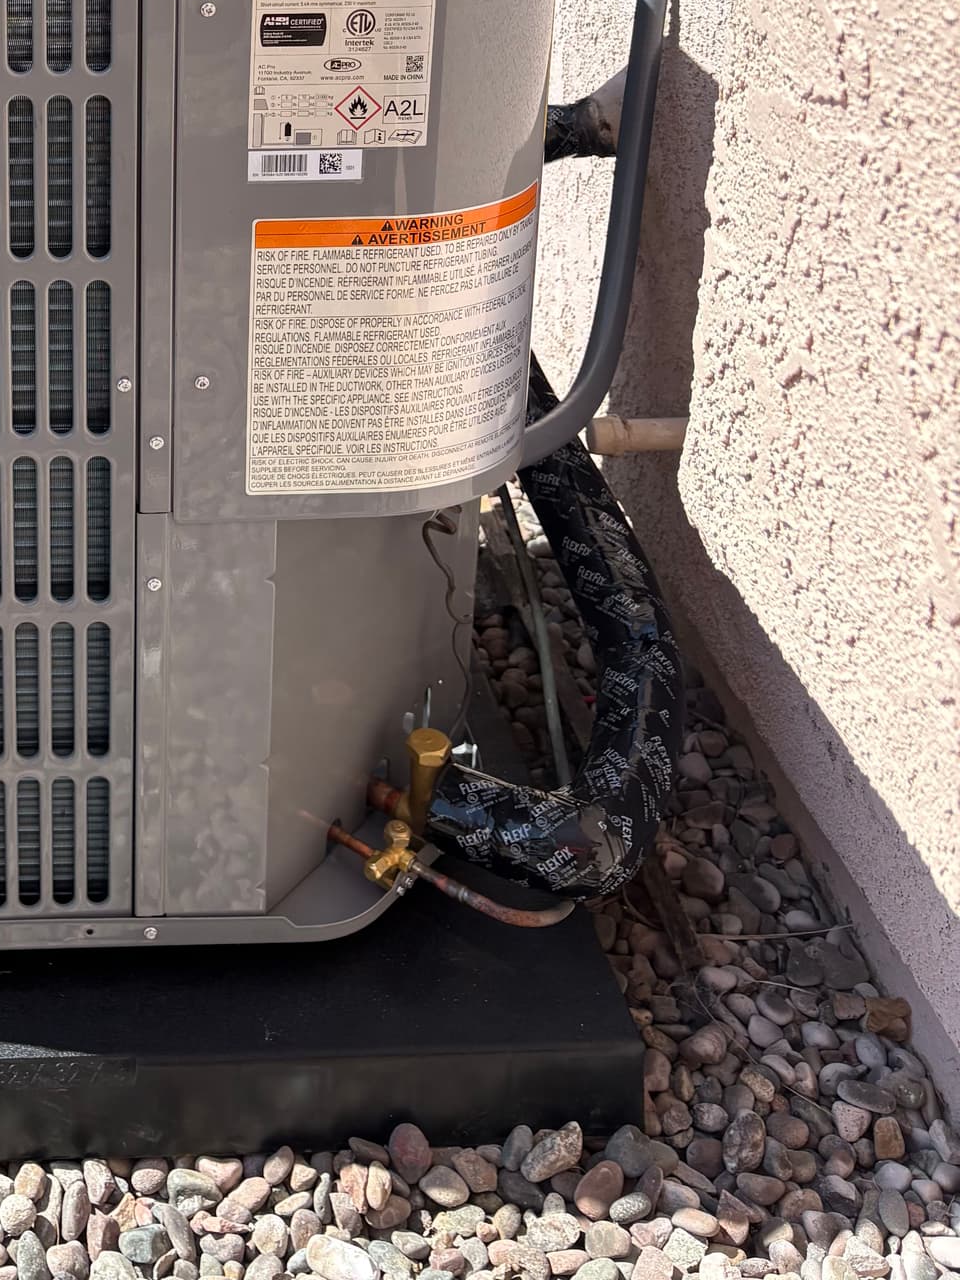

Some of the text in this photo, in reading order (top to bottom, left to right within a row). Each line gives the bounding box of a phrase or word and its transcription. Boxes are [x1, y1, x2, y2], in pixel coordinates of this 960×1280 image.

[384, 100, 423, 116] A2L
[395, 214, 464, 231] WARNING
[368, 222, 486, 245] AVERTISSEMENT
[257, 251, 276, 261] RISK
[278, 251, 289, 261] OF
[313, 249, 361, 260] FLAMMABLE
[363, 246, 419, 259] REFRIGERANT
[445, 242, 455, 253] TO
[456, 240, 465, 252] BE
[257, 264, 291, 275] SERVICE
[346, 263, 358, 273] DO
[360, 262, 377, 273] NOT
[379, 260, 421, 272] PUNCTURE
[424, 252, 473, 270] REFRIGERANT
[256, 270, 447, 288] RISQUE INFLAMMABLE
[256, 291, 272, 301] PAR
[274, 291, 285, 301] DU
[288, 290, 335, 301] PERSONNEL
[337, 290, 348, 300] DE
[350, 289, 385, 300] SERVICE
[418, 286, 429, 297] NE
[431, 282, 459, 296] PERCEZ
[461, 279, 473, 291] PAS
[256, 320, 274, 330] RISK
[276, 319, 287, 329] OF
[311, 318, 345, 329] DISPOSE
[347, 318, 359, 328] OF
[360, 317, 402, 328] PROPERLY
[404, 316, 412, 327] IN
[413, 309, 463, 326] ACCORDANCE
[465, 305, 481, 318] WITH
[314, 328, 419, 342] FLAMMABLE REFRIGERANT
[255, 337, 440, 355] RISQUE DISPOSEZ CORRECTEMENT
[254, 370, 272, 381] RISK
[274, 370, 285, 380] OF
[287, 370, 305, 380] FIRE
[313, 369, 353, 379] AUXILIARY
[355, 368, 389, 379] DEVICES
[391, 366, 416, 377] WHICH
[418, 364, 434, 375] MAY
[435, 362, 444, 373] BE
[446, 356, 475, 372] IGNITION
[380, 355, 392, 365] OU
[254, 383, 264, 393] BE
[267, 382, 308, 393] INSTALLED
[310, 382, 318, 392] IN
[320, 382, 335, 392] THE
[386, 379, 413, 390] OTHER
[415, 376, 434, 388] THAN
[435, 369, 470, 386] AUXILIARY
[254, 396, 270, 406] USE
[272, 395, 291, 406] WITH
[293, 395, 309, 405] THE
[311, 394, 346, 405] SPECIFIC
[394, 392, 410, 403] SEE
[254, 408, 283, 418] RISQUE
[335, 406, 350, 417] LES
[352, 404, 400, 416] DISPOSITIFS
[401, 399, 445, 414] AUXILIAIRES
[446, 391, 477, 409] POUVANT
[320, 419, 330, 429] NE
[332, 418, 366, 429] DOIVENT
[368, 417, 383, 428] PAS
[446, 407, 464, 421] DANS
[465, 404, 477, 417] LES
[253, 433, 269, 443] QUE
[271, 433, 286, 443] LES
[288, 432, 335, 443] DISPOSITIFS
[337, 430, 384, 442] AUXILIAIRES
[429, 423, 449, 436] POUR
[346, 444, 365, 454] VOIR
[367, 443, 382, 454] LES
